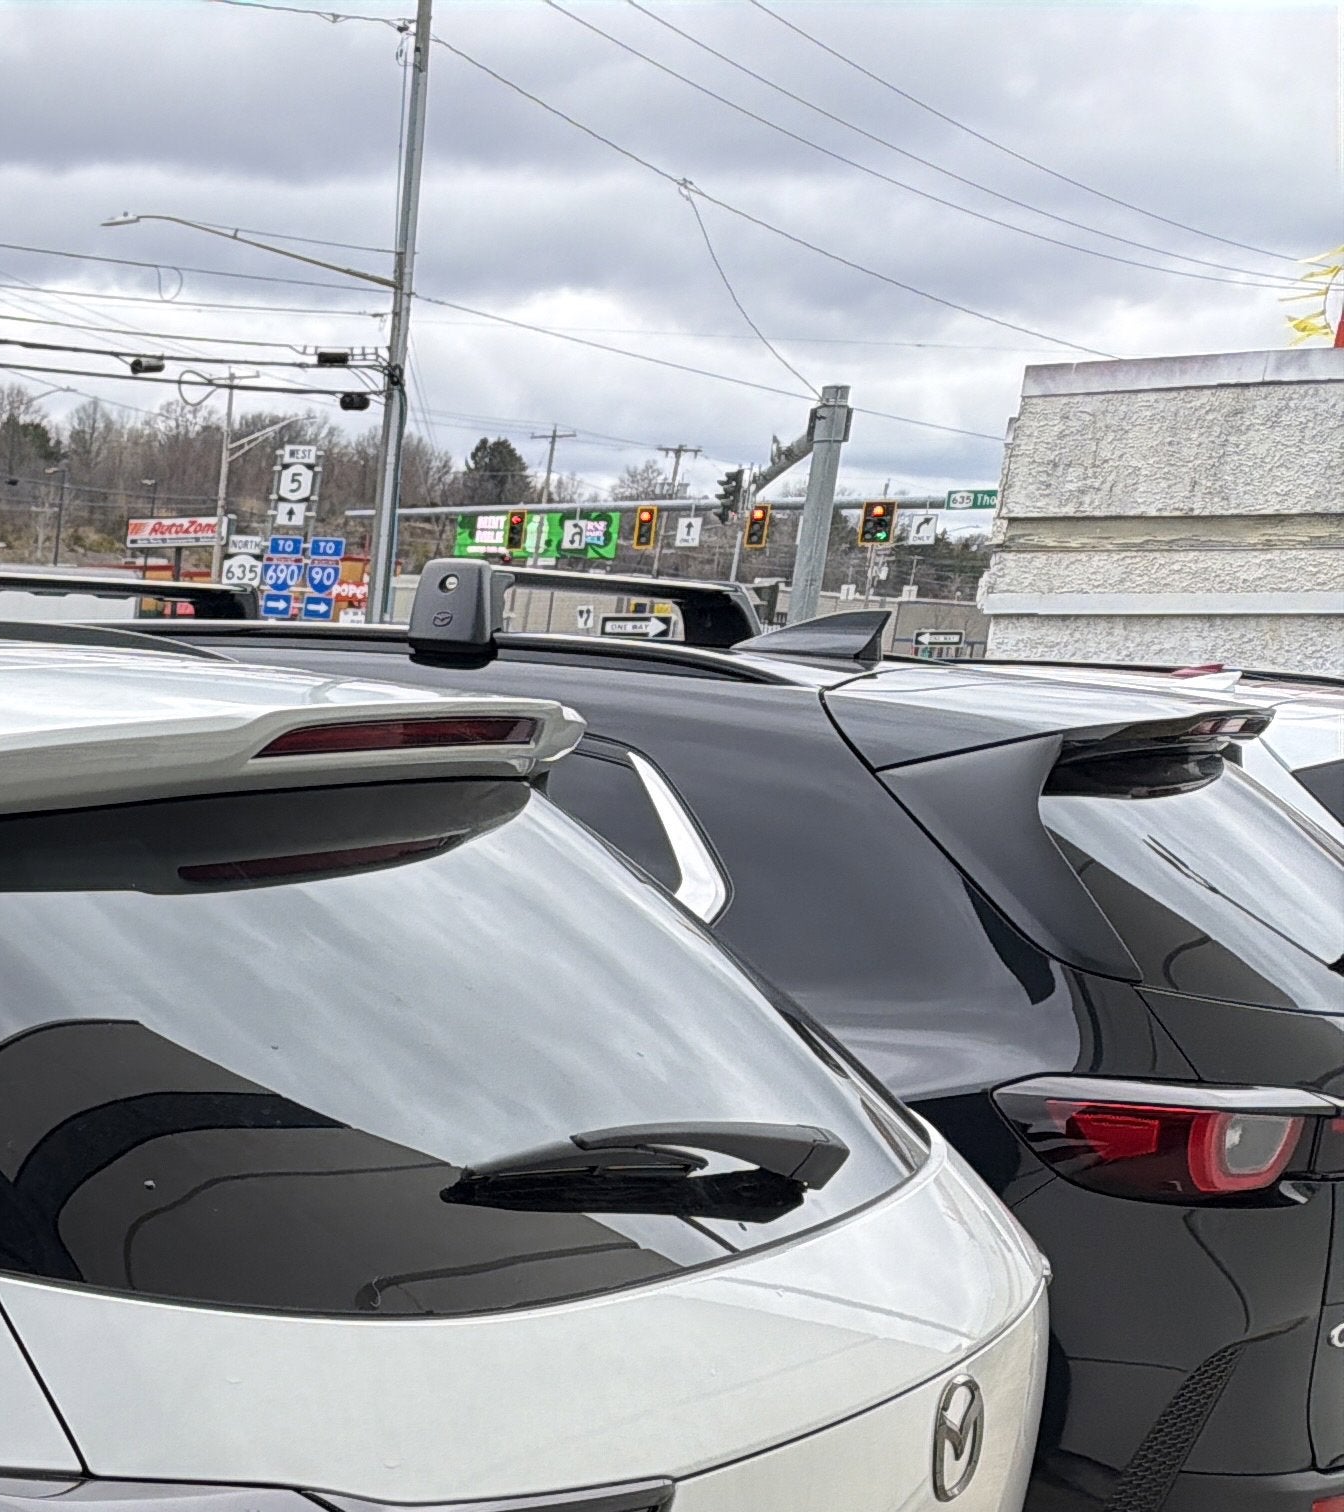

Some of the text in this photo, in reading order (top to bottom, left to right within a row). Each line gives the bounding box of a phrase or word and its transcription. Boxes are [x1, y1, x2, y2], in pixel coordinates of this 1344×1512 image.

[288, 449, 312, 460] WEST
[288, 472, 303, 493] 5
[951, 494, 972, 505] 635
[149, 520, 217, 536] AutoZon
[230, 539, 261, 550] NORTH
[277, 539, 294, 552] TO
[318, 541, 335, 554] TO
[225, 563, 259, 582] 635
[266, 564, 299, 586] 690
[311, 567, 335, 585] 90
[331, 582, 368, 599] POPE
[611, 623, 627, 631] ONE
